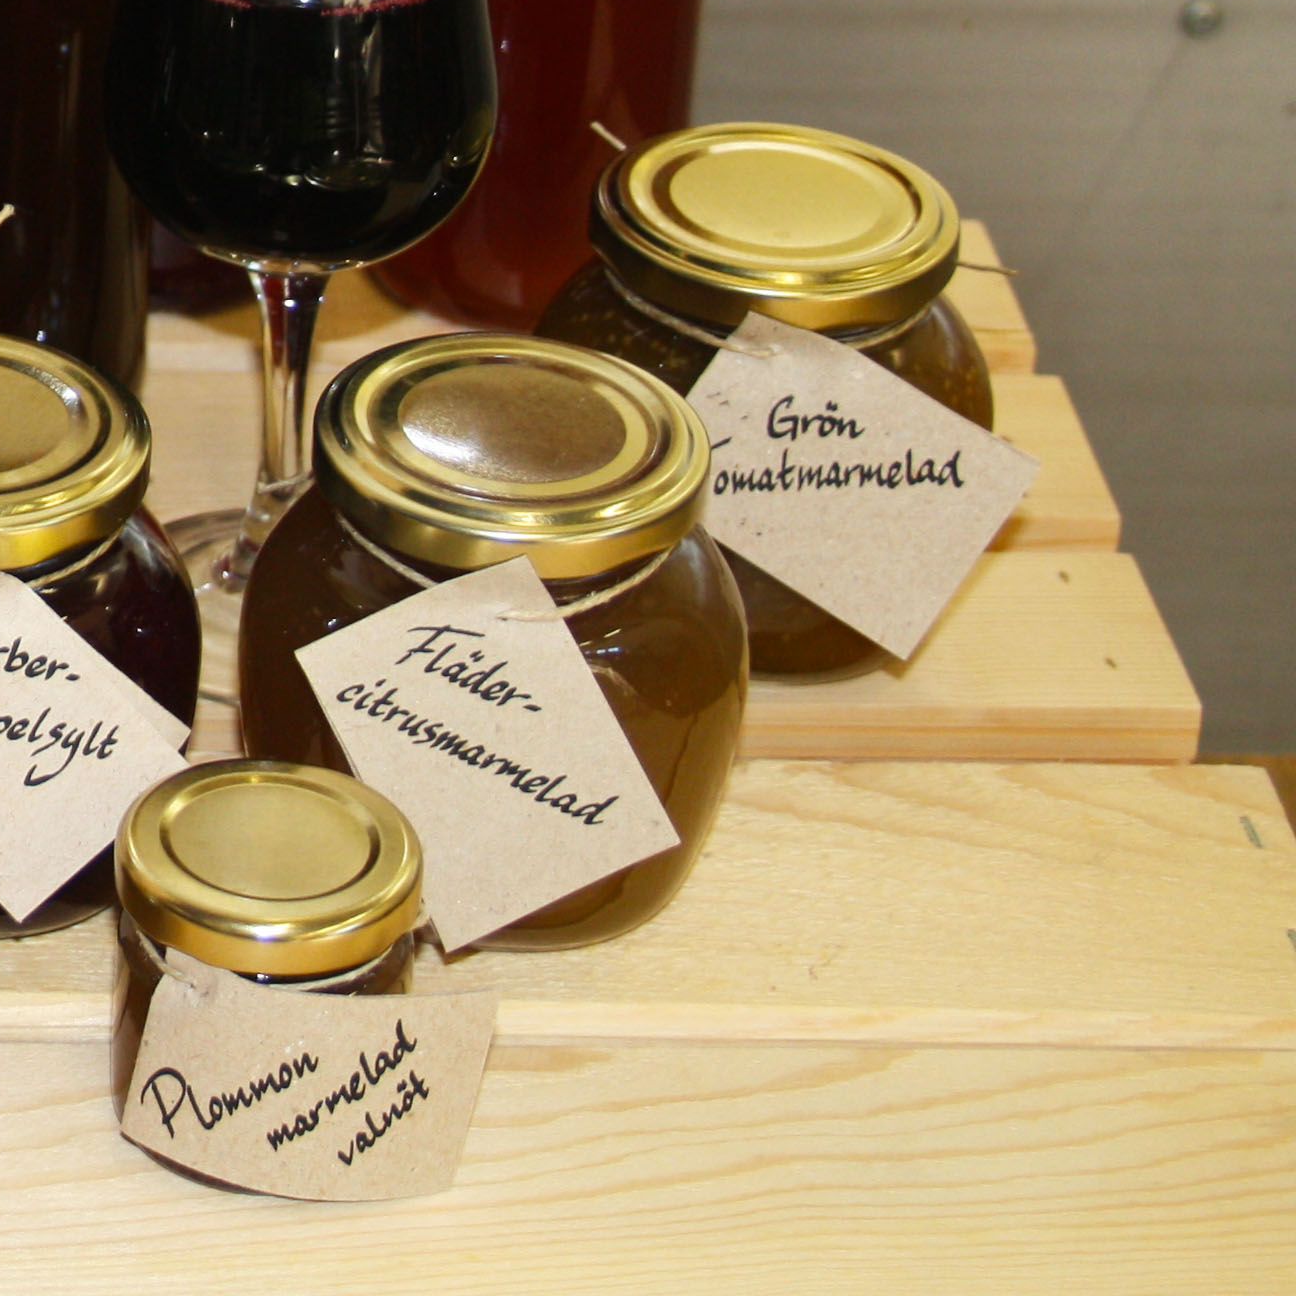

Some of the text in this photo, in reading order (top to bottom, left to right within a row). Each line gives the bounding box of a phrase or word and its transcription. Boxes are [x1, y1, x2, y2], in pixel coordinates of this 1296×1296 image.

[767, 395, 864, 441] Grön
[711, 437, 965, 495] omatmarmelad
[395, 625, 542, 714] Fläder-
[336, 681, 618, 829] citrusmarmelad
[141, 1048, 320, 1140] Plommon
[267, 1018, 419, 1152] marmelad
[337, 1074, 431, 1167] valnöt
